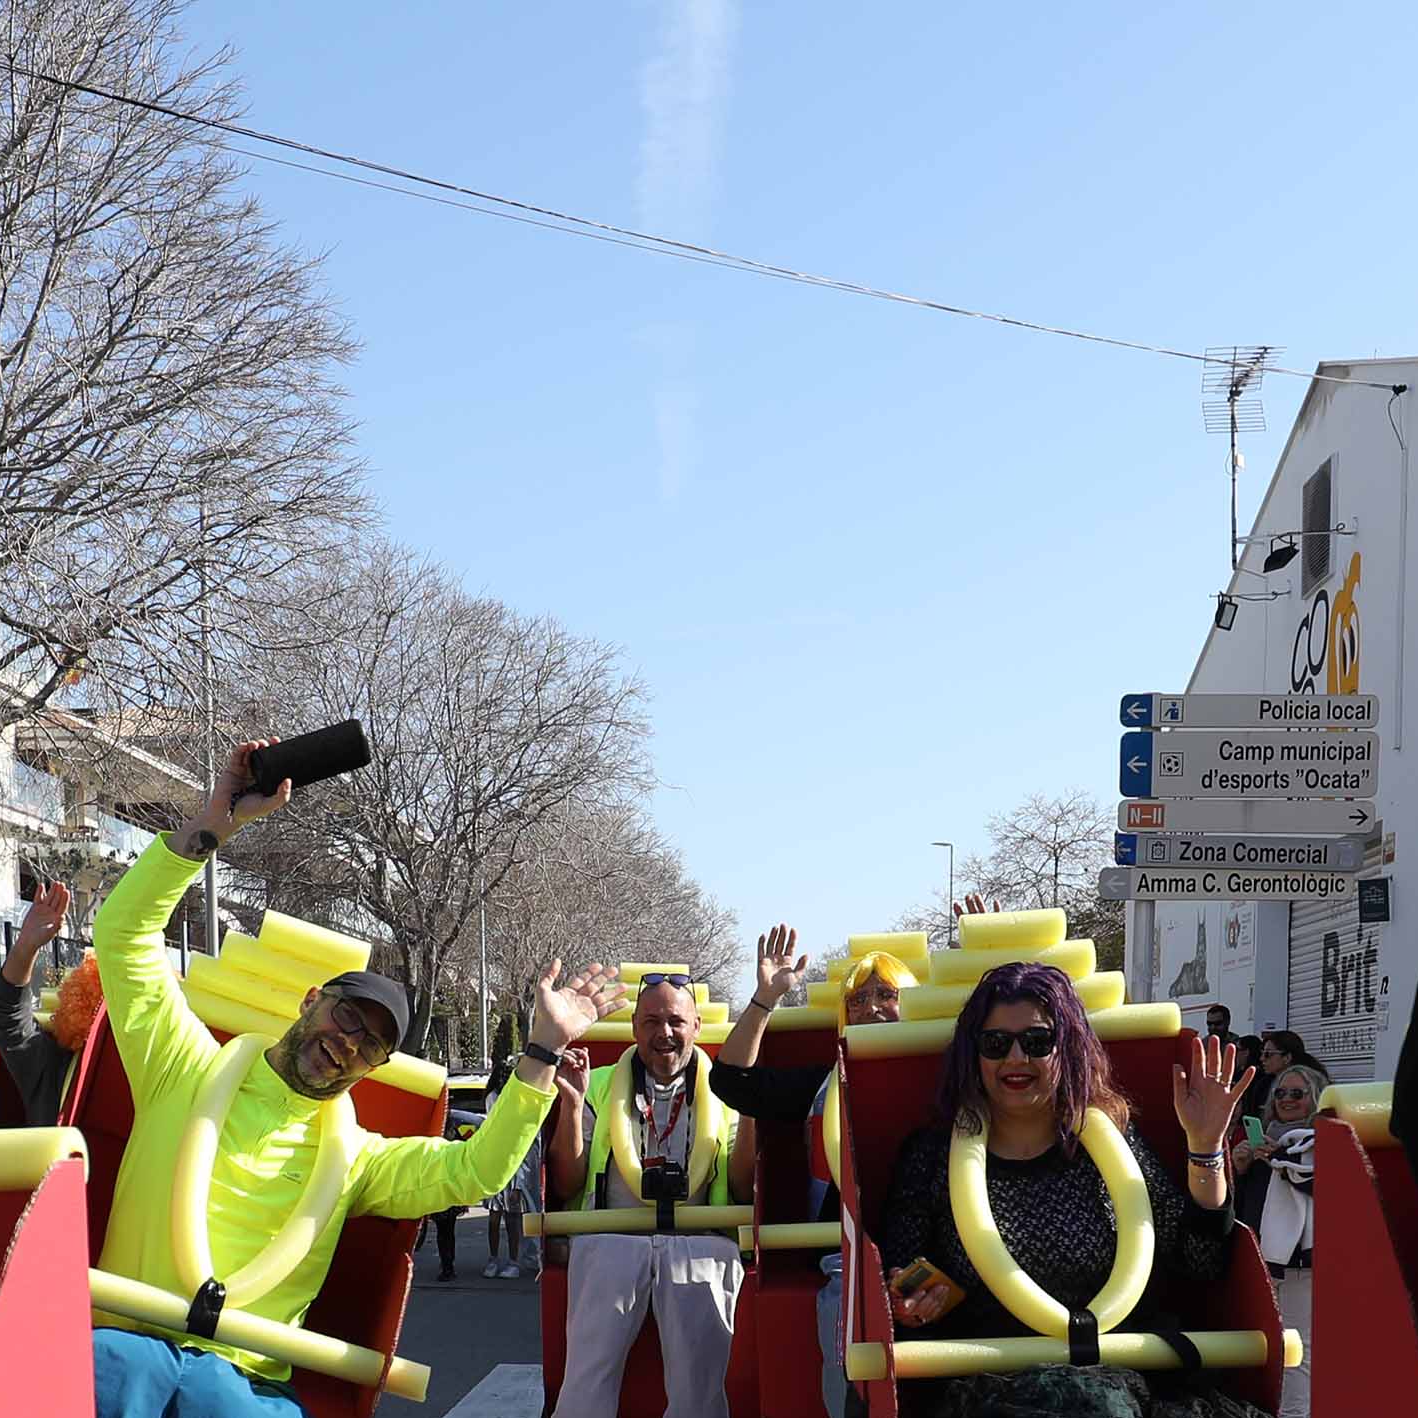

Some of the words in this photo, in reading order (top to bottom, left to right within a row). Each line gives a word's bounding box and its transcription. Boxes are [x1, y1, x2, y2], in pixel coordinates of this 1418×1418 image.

[1259, 700, 1320, 720] Policia
[1327, 700, 1371, 720] local
[1219, 741, 1274, 764] Camp
[1280, 742, 1371, 765] municipal
[1202, 770, 1290, 793] d'esports
[1179, 842, 1227, 862] Zona
[1233, 843, 1328, 864] Comercial
[1137, 873, 1196, 893] Amma
[1203, 873, 1221, 893] C.
[1227, 872, 1346, 897] Gerontològic
[1321, 924, 1378, 1018] Brit
